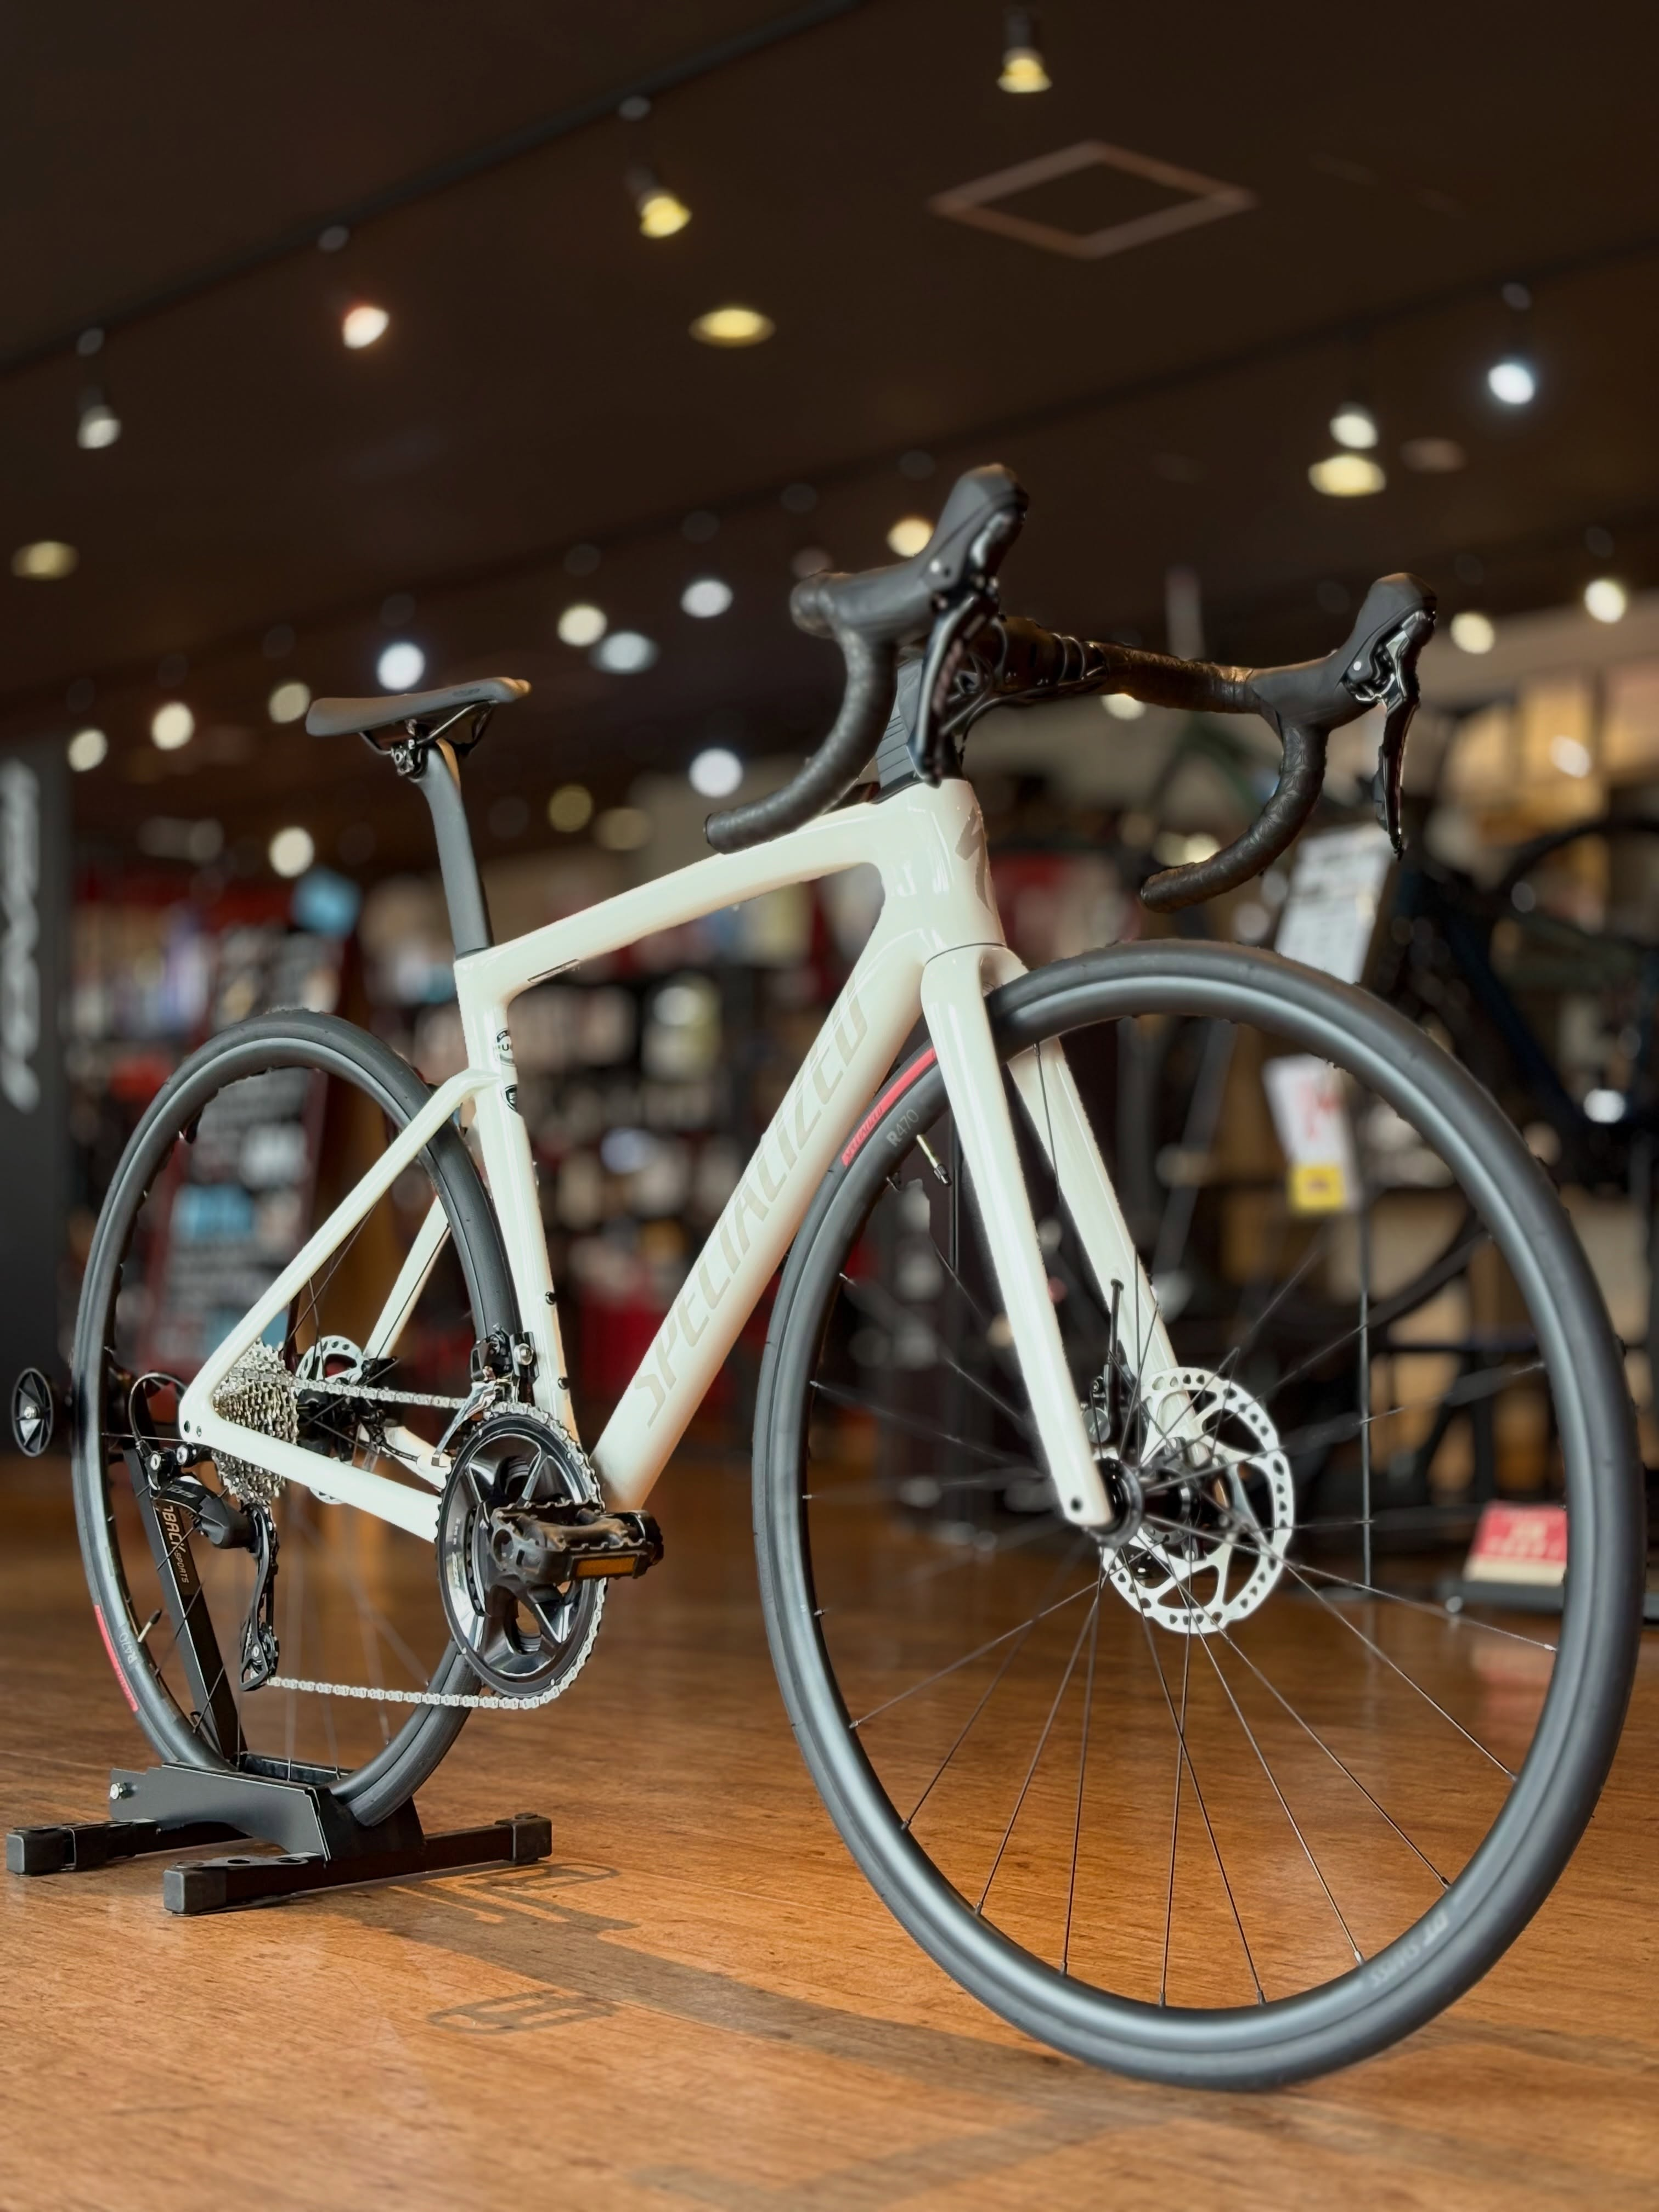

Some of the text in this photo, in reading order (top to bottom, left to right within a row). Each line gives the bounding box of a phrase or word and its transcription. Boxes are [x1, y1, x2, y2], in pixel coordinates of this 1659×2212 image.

[887, 1109, 919, 1147] R470
[634, 974, 868, 1429] SPECIALIZED
[119, 1632, 138, 1665] R470
